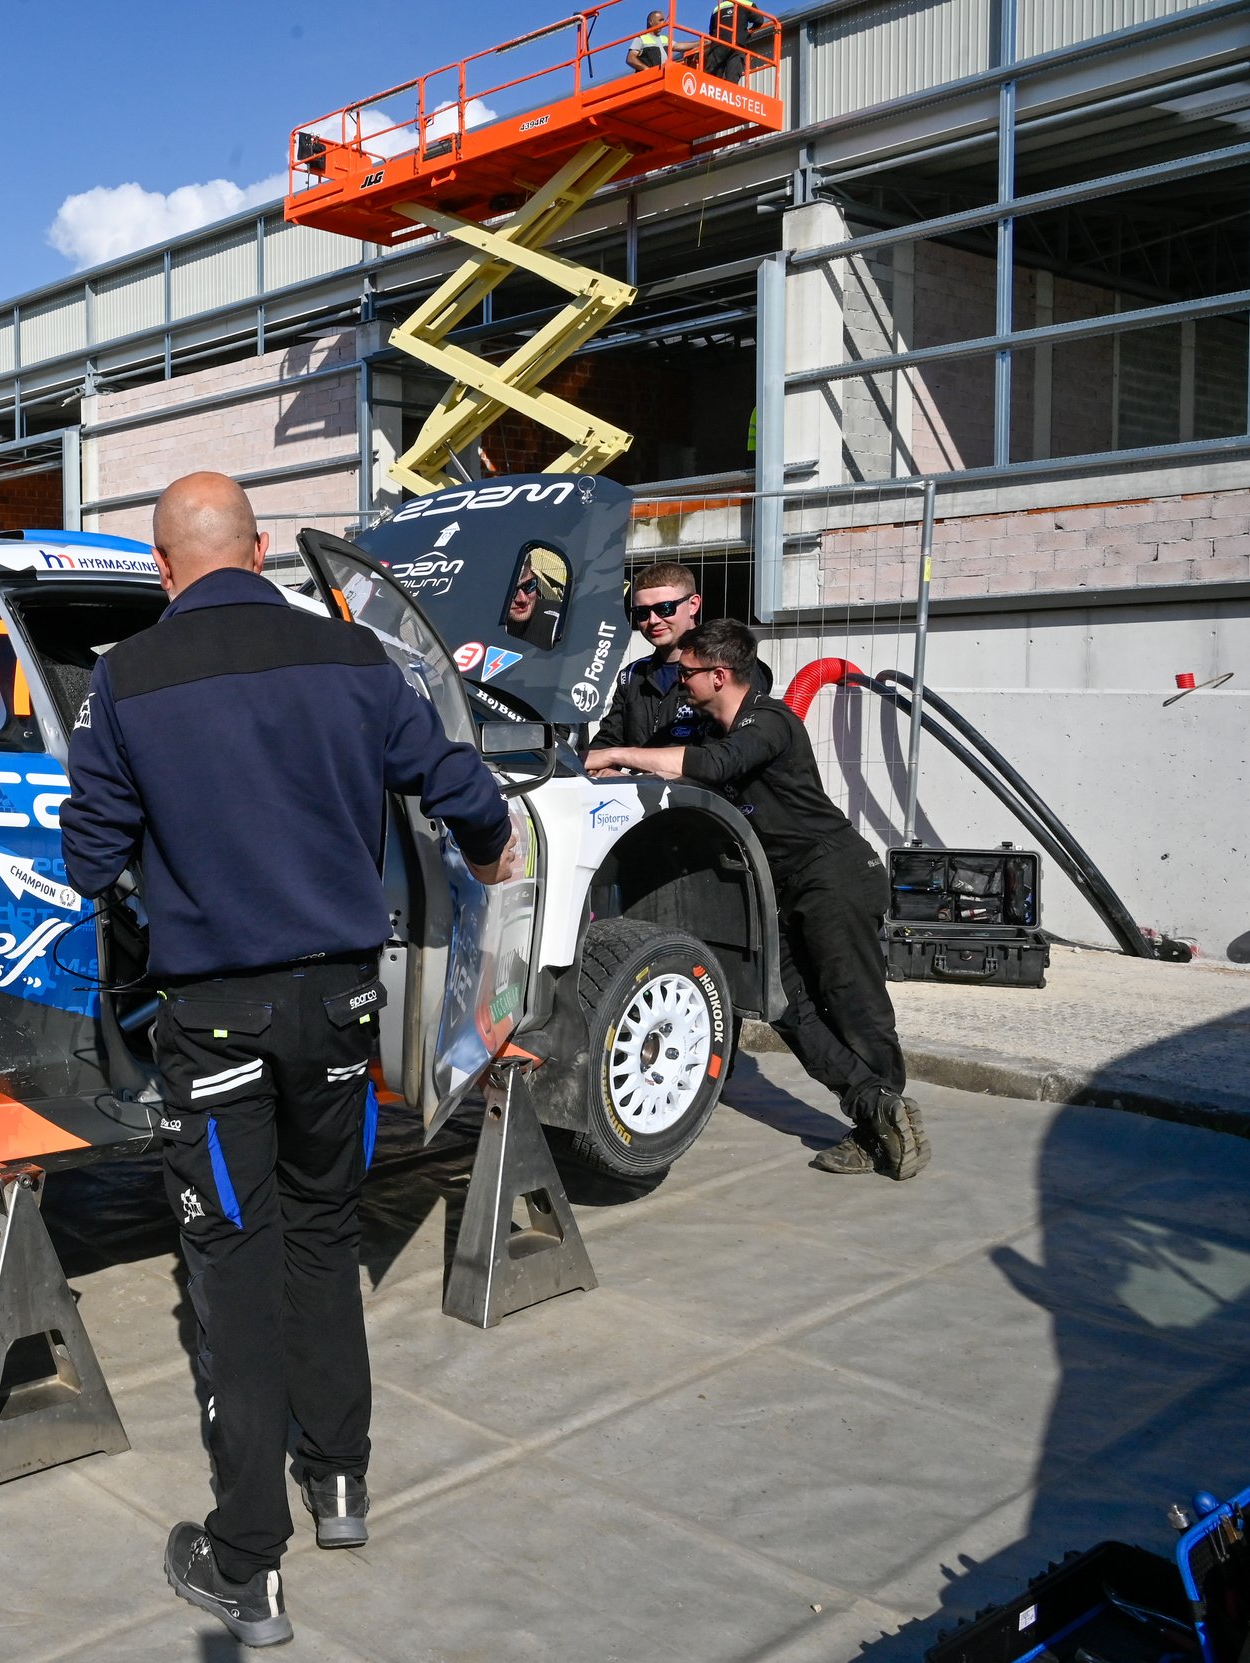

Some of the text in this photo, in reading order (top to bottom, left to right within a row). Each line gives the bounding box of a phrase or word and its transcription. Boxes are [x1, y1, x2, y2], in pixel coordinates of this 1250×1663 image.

[700, 82, 767, 117] AREALSTEEL
[519, 115, 550, 132] 4394RT
[360, 171, 385, 189] JLG
[584, 620, 617, 682] Forss IT
[597, 812, 630, 827] Sjötorps
[9, 865, 57, 898] CHAMPION
[350, 989, 377, 1009] sparco
